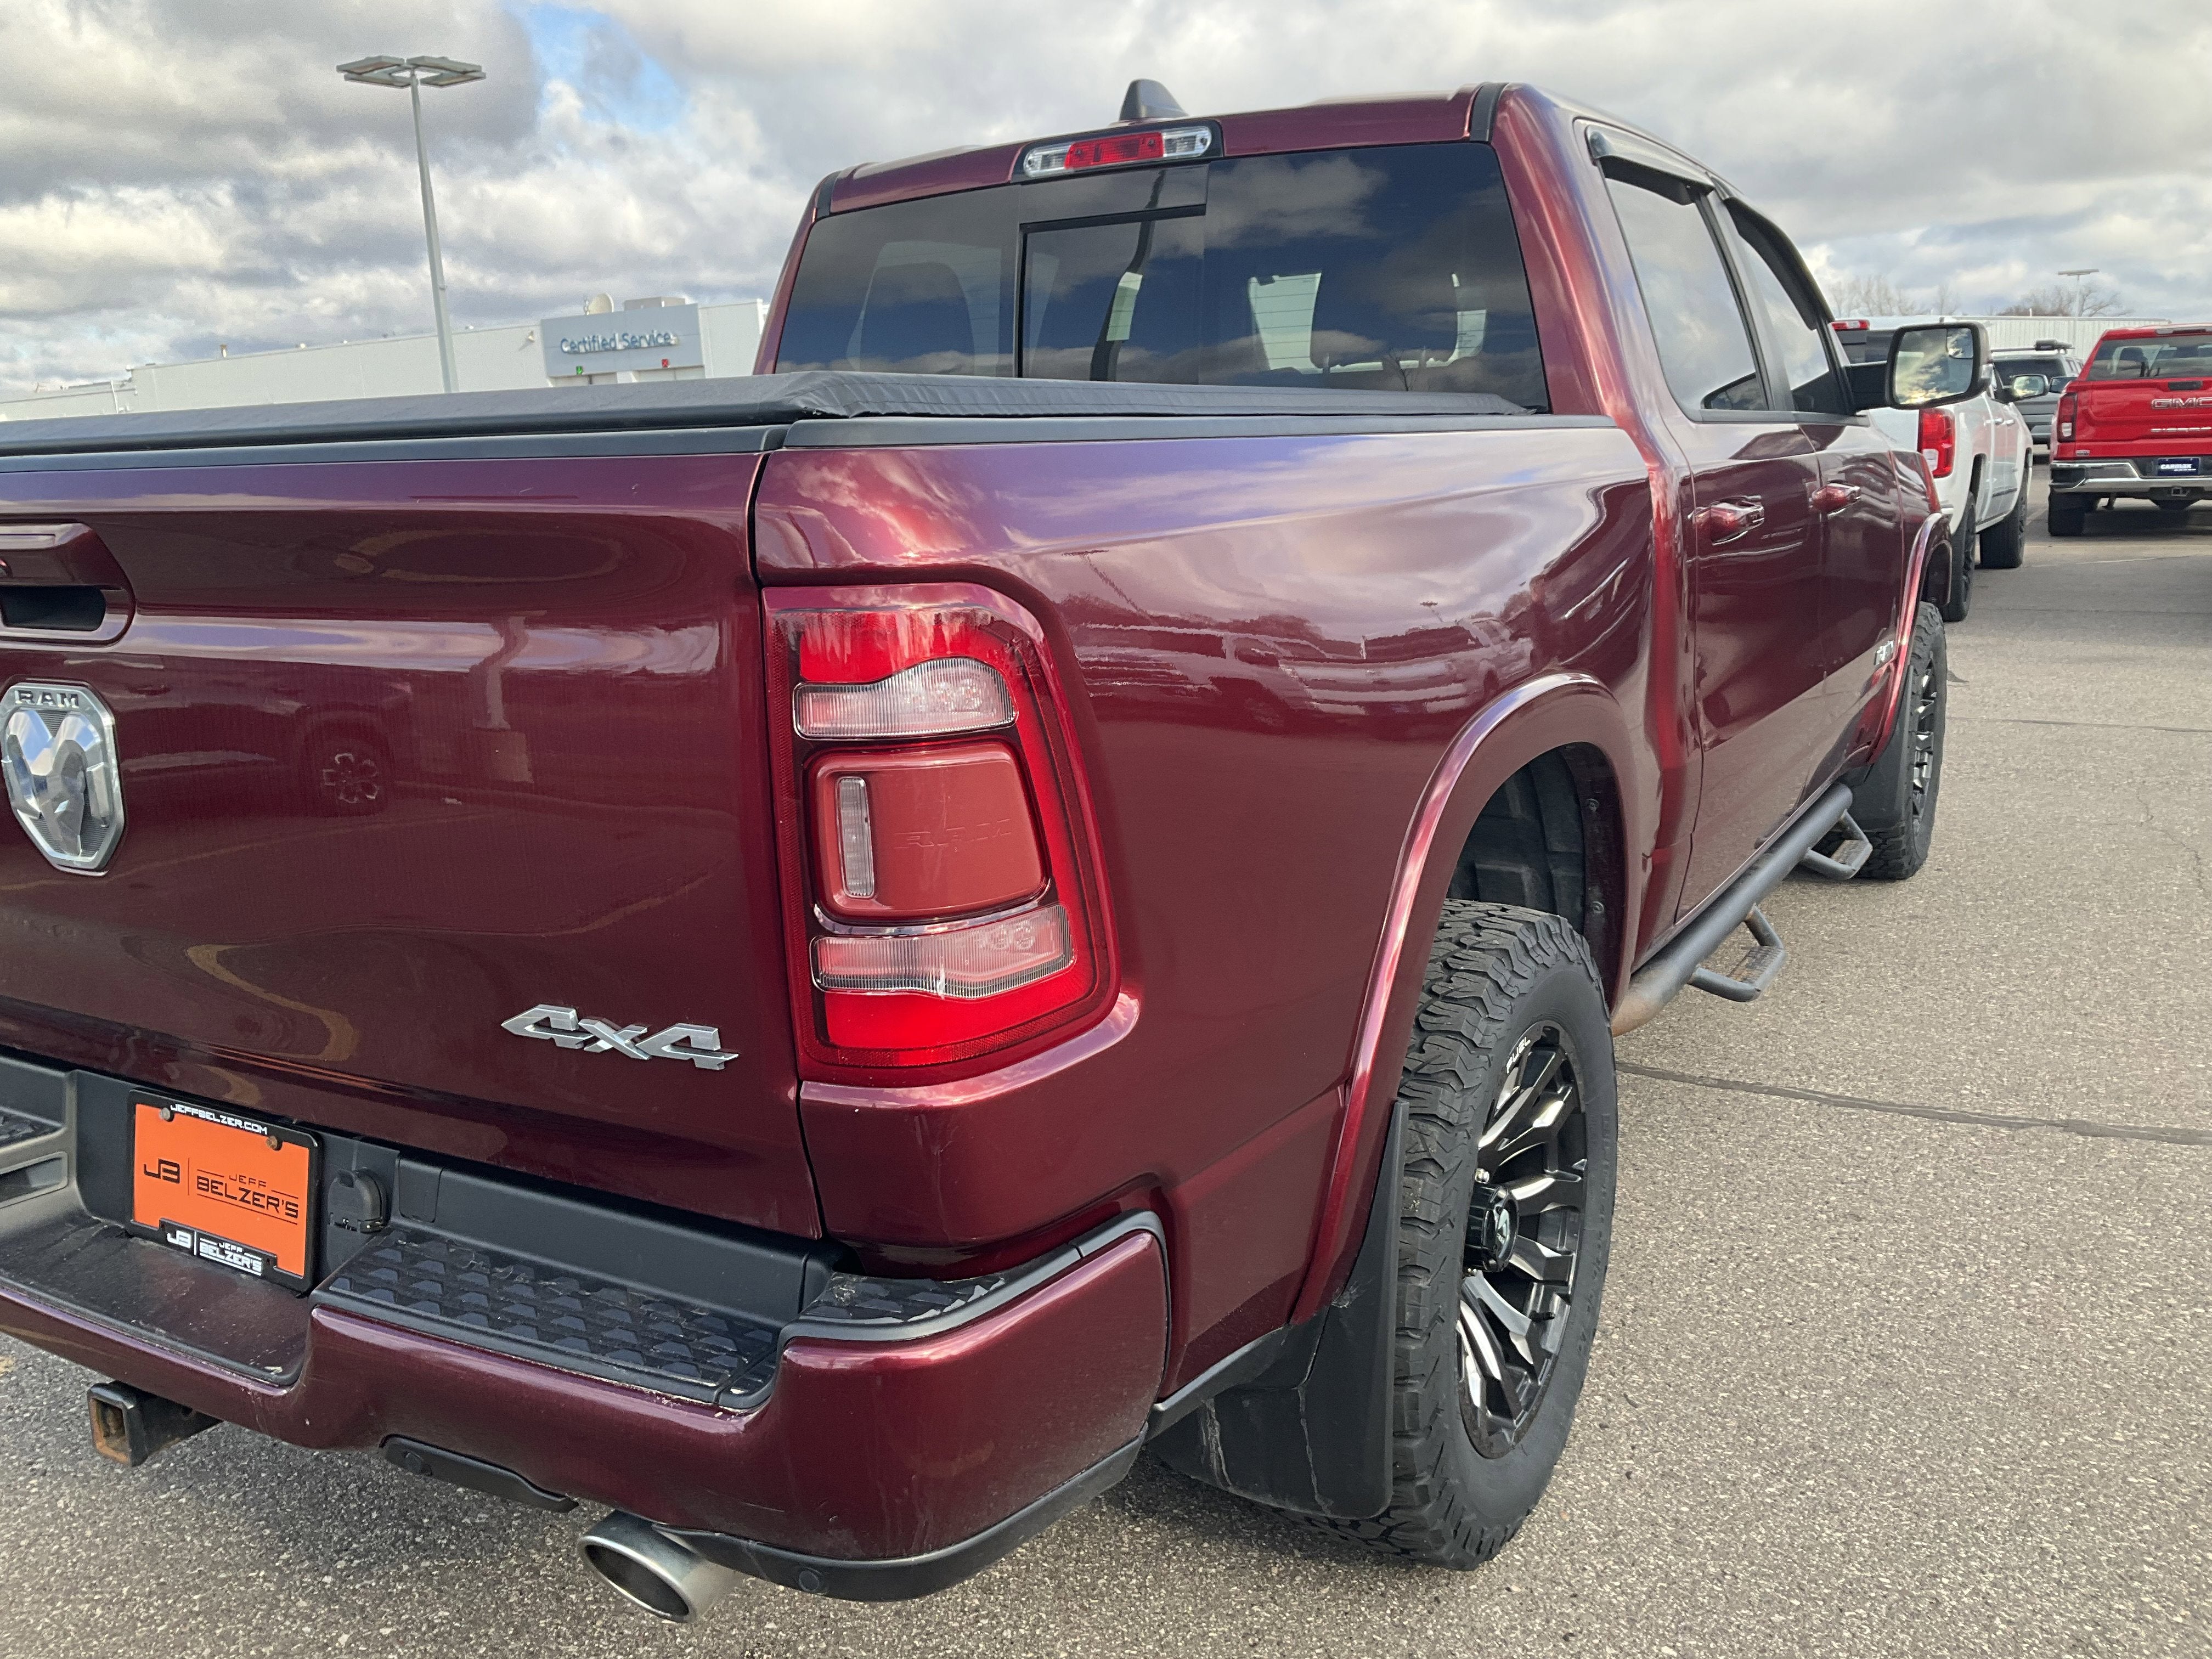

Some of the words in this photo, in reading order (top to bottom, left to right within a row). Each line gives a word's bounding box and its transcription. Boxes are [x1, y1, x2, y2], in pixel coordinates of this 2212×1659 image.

[560, 332, 618, 354] Certified
[622, 329, 674, 349] Service
[2151, 397, 2212, 409] GMC
[14, 690, 80, 709] RAM
[894, 818, 1012, 849] RAM
[1506, 1036, 1531, 1074] FUEL
[170, 1103, 267, 1135] JEFFBELZER.COM
[229, 1173, 267, 1189] JEFF
[196, 1176, 299, 1219] BELZER'S
[199, 1241, 262, 1273] BELZER'S
[219, 1242, 242, 1252] JEFF
